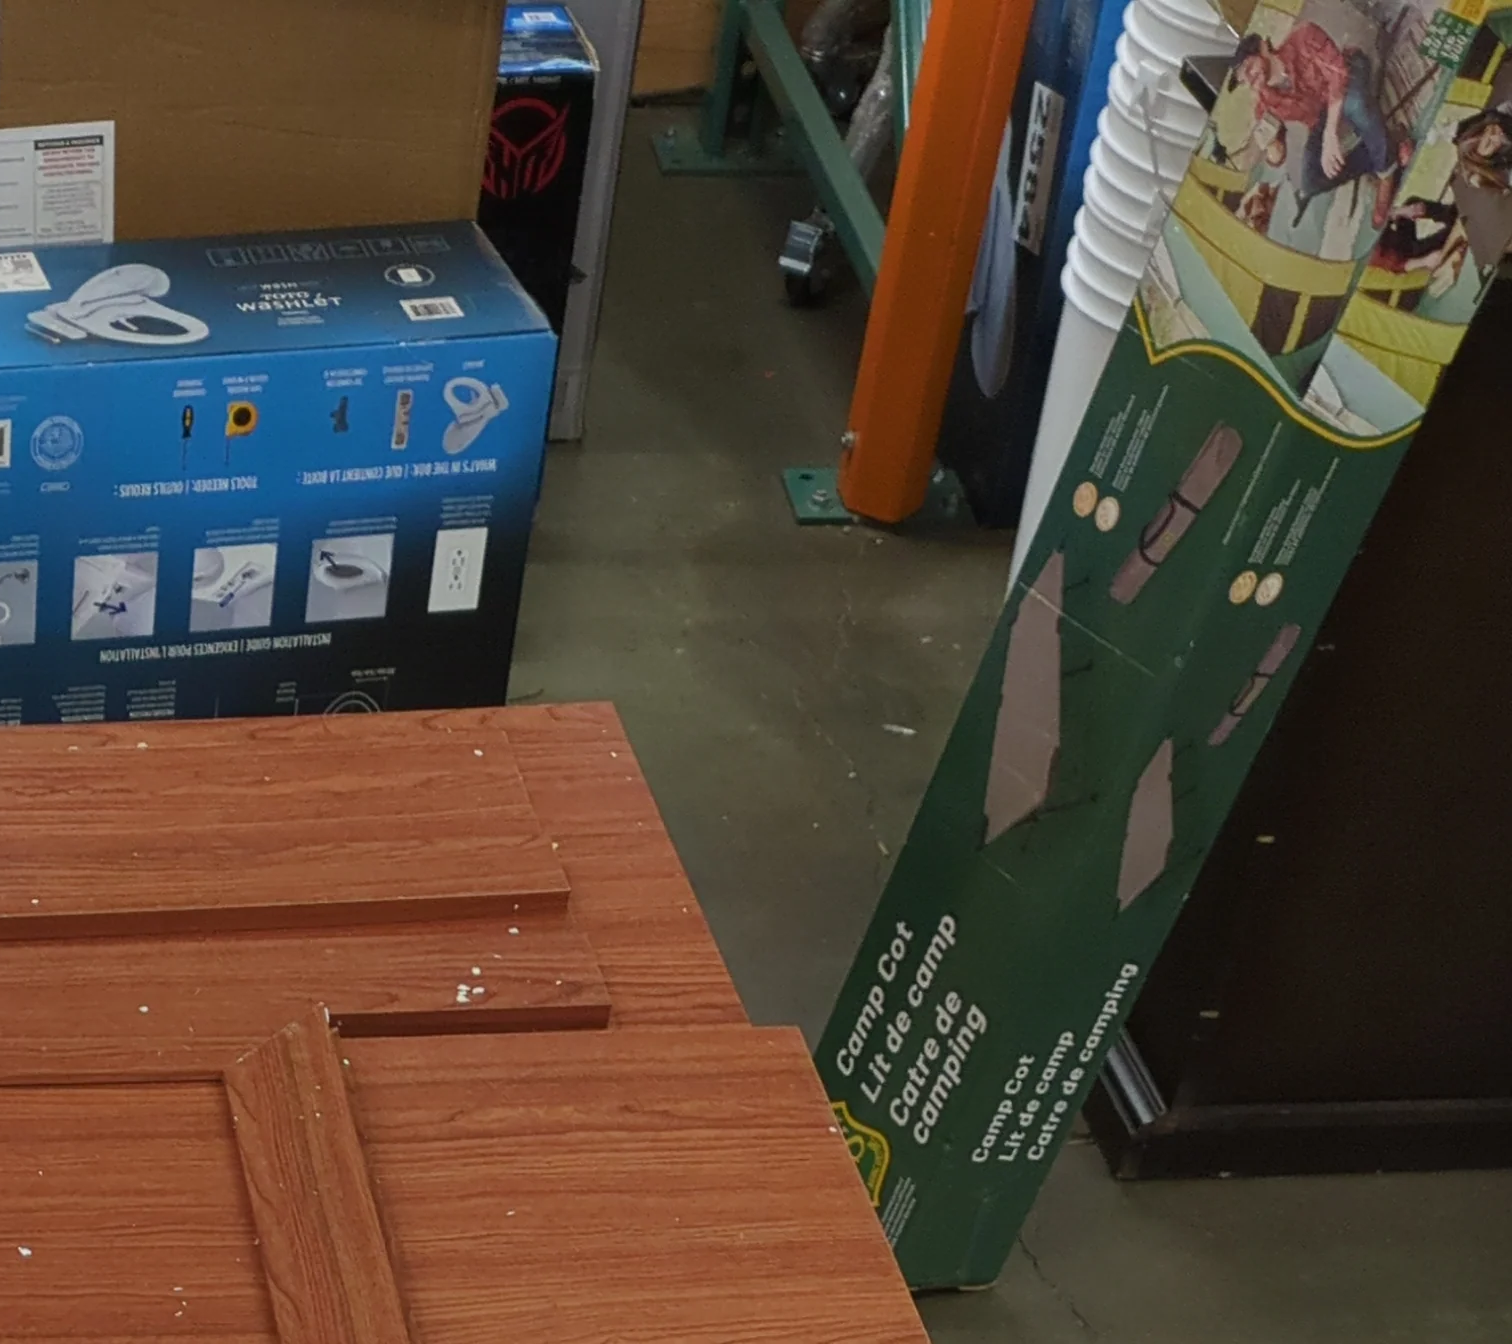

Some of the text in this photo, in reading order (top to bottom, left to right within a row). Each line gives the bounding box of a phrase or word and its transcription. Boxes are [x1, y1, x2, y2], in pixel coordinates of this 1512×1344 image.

[168, 643, 193, 658] POUR
[194, 639, 239, 656] EXIGENCES
[246, 637, 271, 651] GUIDE
[273, 632, 333, 650] INSTALLATION
[836, 920, 914, 1077] Camp Cot
[860, 1052, 892, 1104] Lit
[886, 1010, 912, 1053] de
[907, 914, 957, 1008] camp
[889, 991, 962, 1127] Catre de
[1027, 962, 1139, 1161] Catre de camping
[913, 1004, 988, 1145] camping
[971, 1054, 1036, 1163] Camp Cot
[997, 1030, 1076, 1162] Lit de camp
